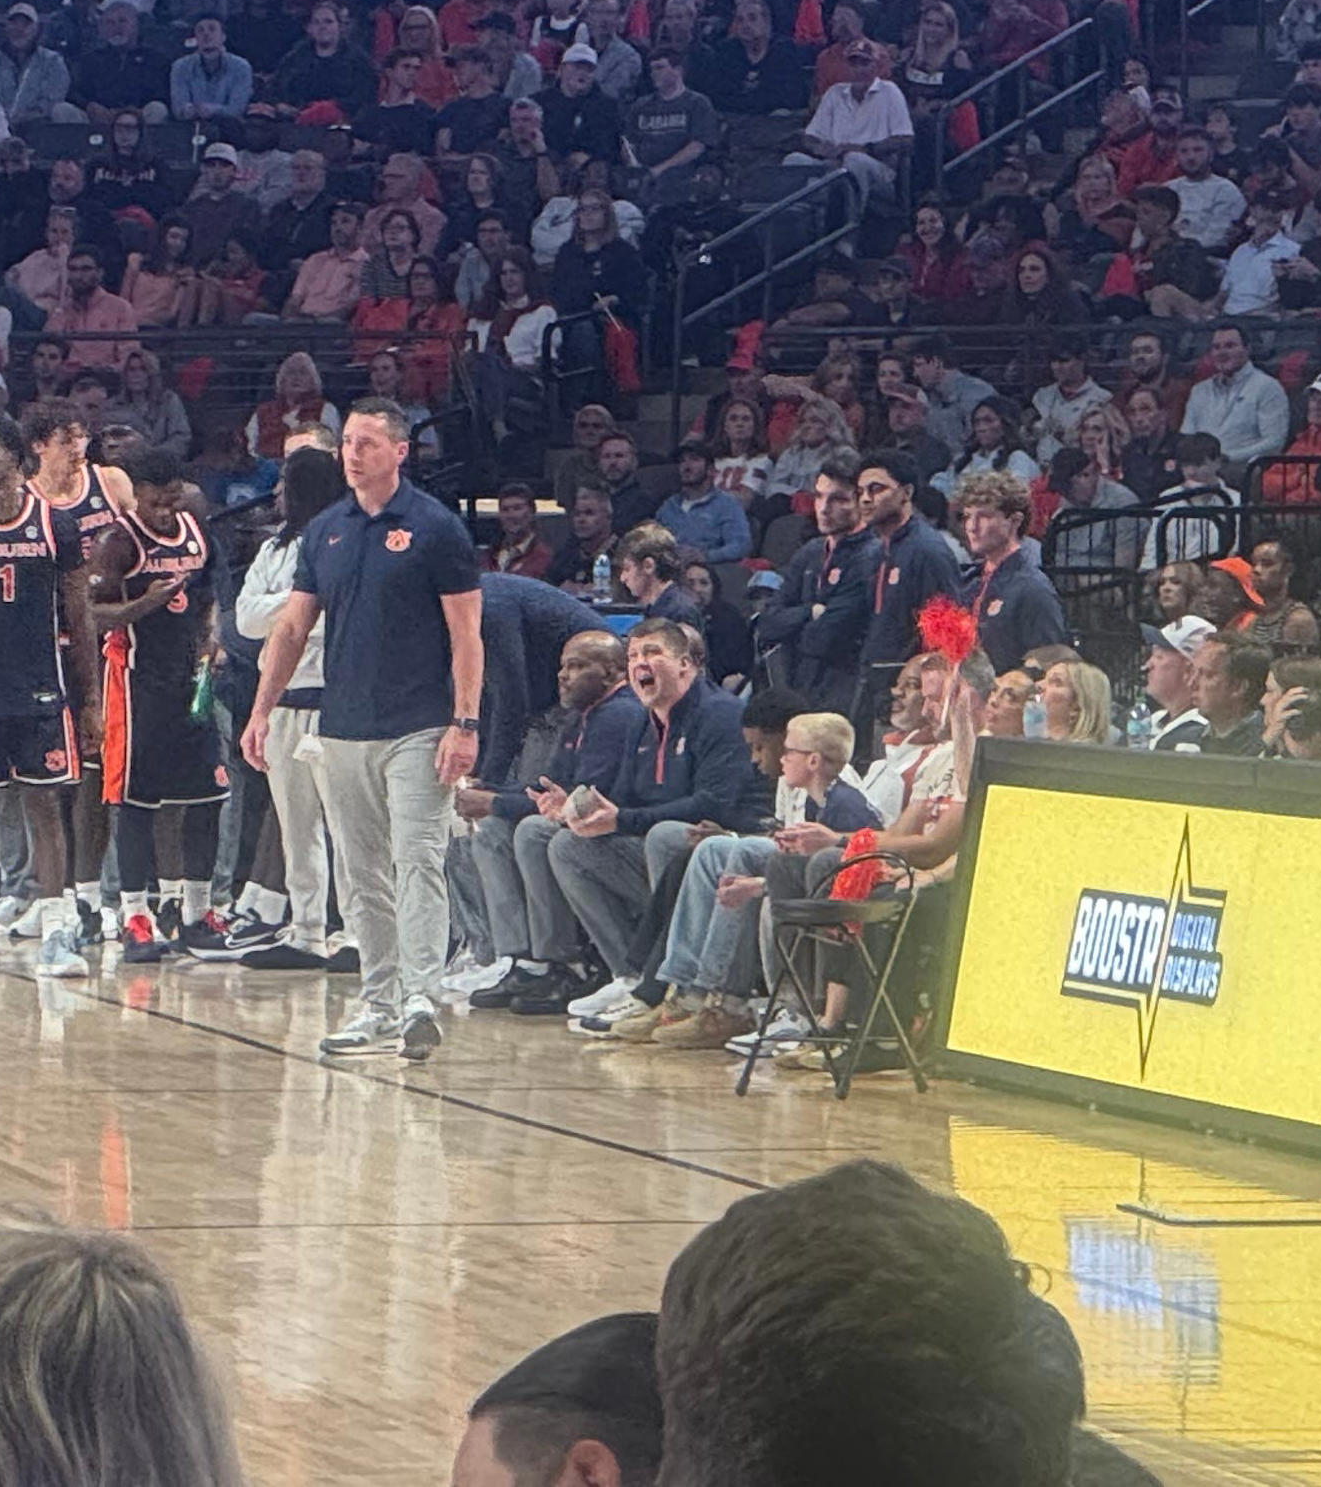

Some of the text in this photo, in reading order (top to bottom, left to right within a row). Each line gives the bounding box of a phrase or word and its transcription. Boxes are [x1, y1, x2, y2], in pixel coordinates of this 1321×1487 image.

[1067, 896, 1166, 984] BOOSTR
[1170, 912, 1218, 953] DIGITAL
[1161, 954, 1221, 999] DISPLAYS
